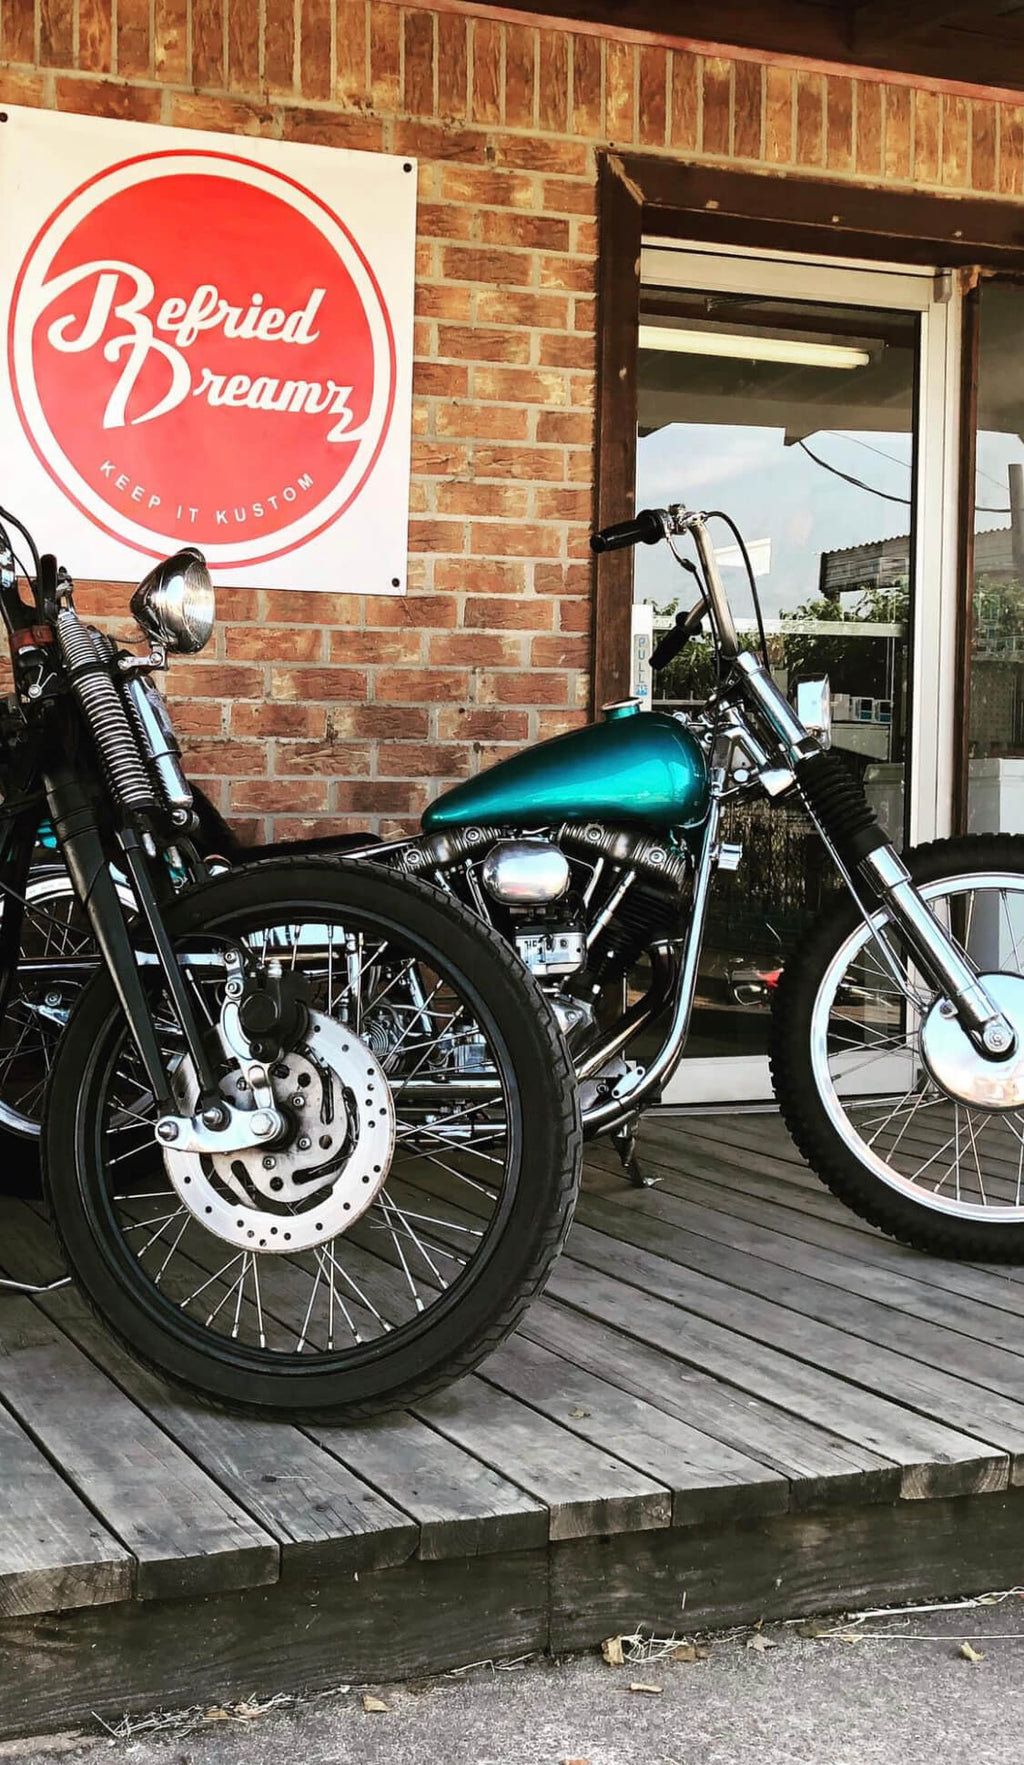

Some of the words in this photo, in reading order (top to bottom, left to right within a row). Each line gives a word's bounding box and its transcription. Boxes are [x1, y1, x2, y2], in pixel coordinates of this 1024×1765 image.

[44, 259, 327, 354] Befried
[102, 332, 365, 442] Dreamz
[100, 459, 162, 508] KEEP
[176, 504, 199, 524] IT
[216, 472, 315, 525] KUSTOM
[638, 637, 646, 684] PULL
